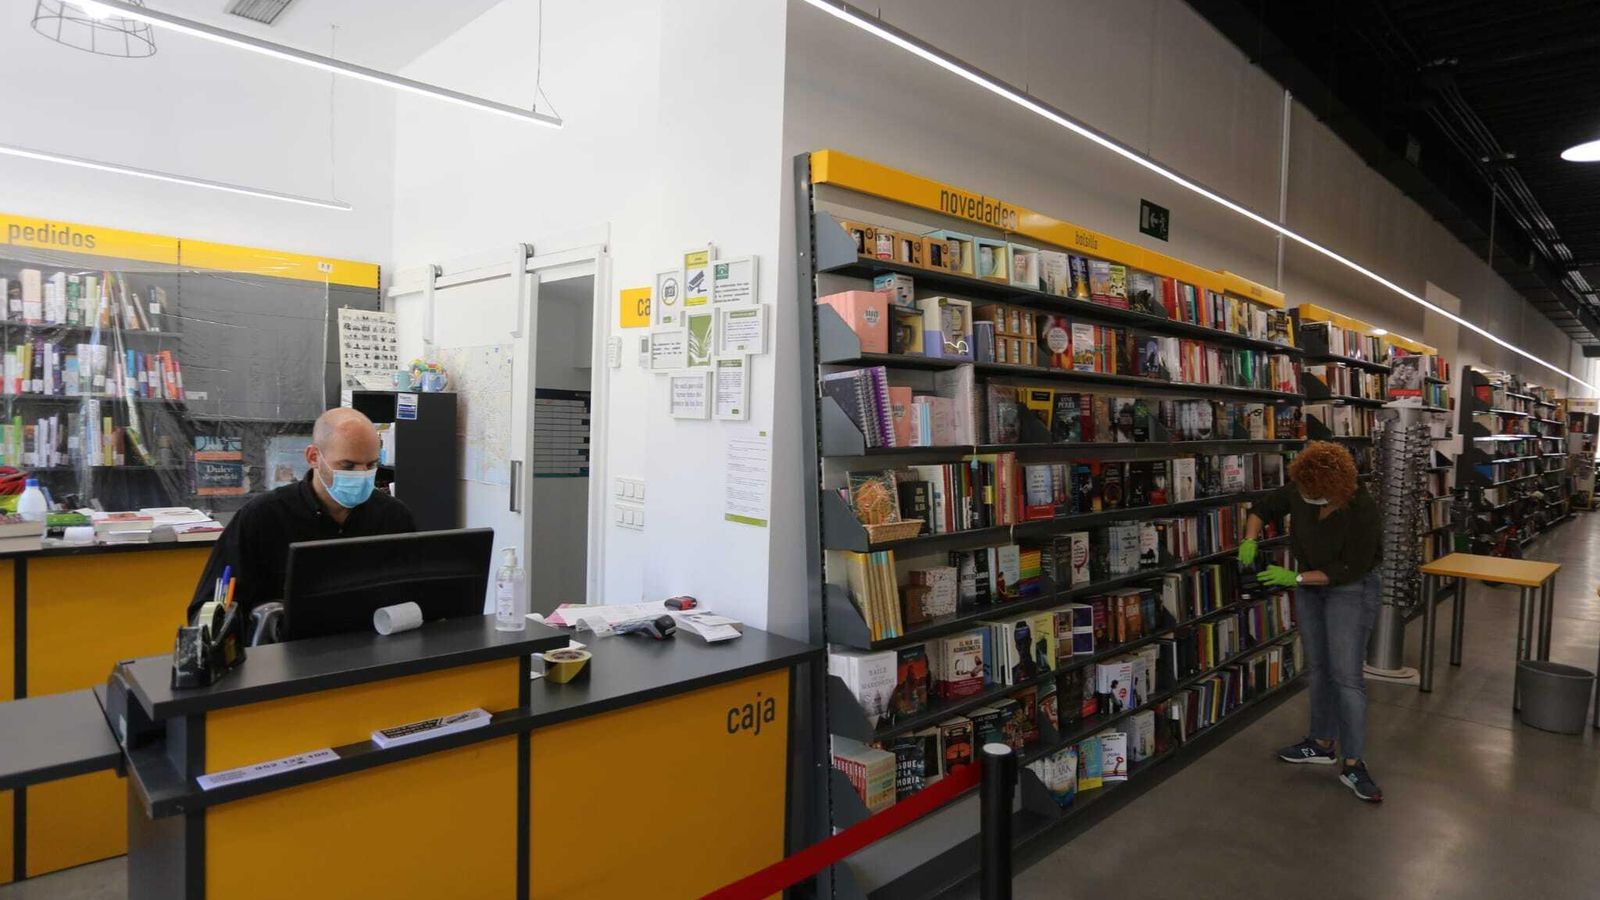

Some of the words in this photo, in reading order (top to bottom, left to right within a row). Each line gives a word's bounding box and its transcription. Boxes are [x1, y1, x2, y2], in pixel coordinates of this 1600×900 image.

[940, 189, 1016, 229] novedades
[8, 223, 96, 249] pedidos
[1075, 230, 1098, 250] bolsillo
[727, 692, 775, 736] caja
